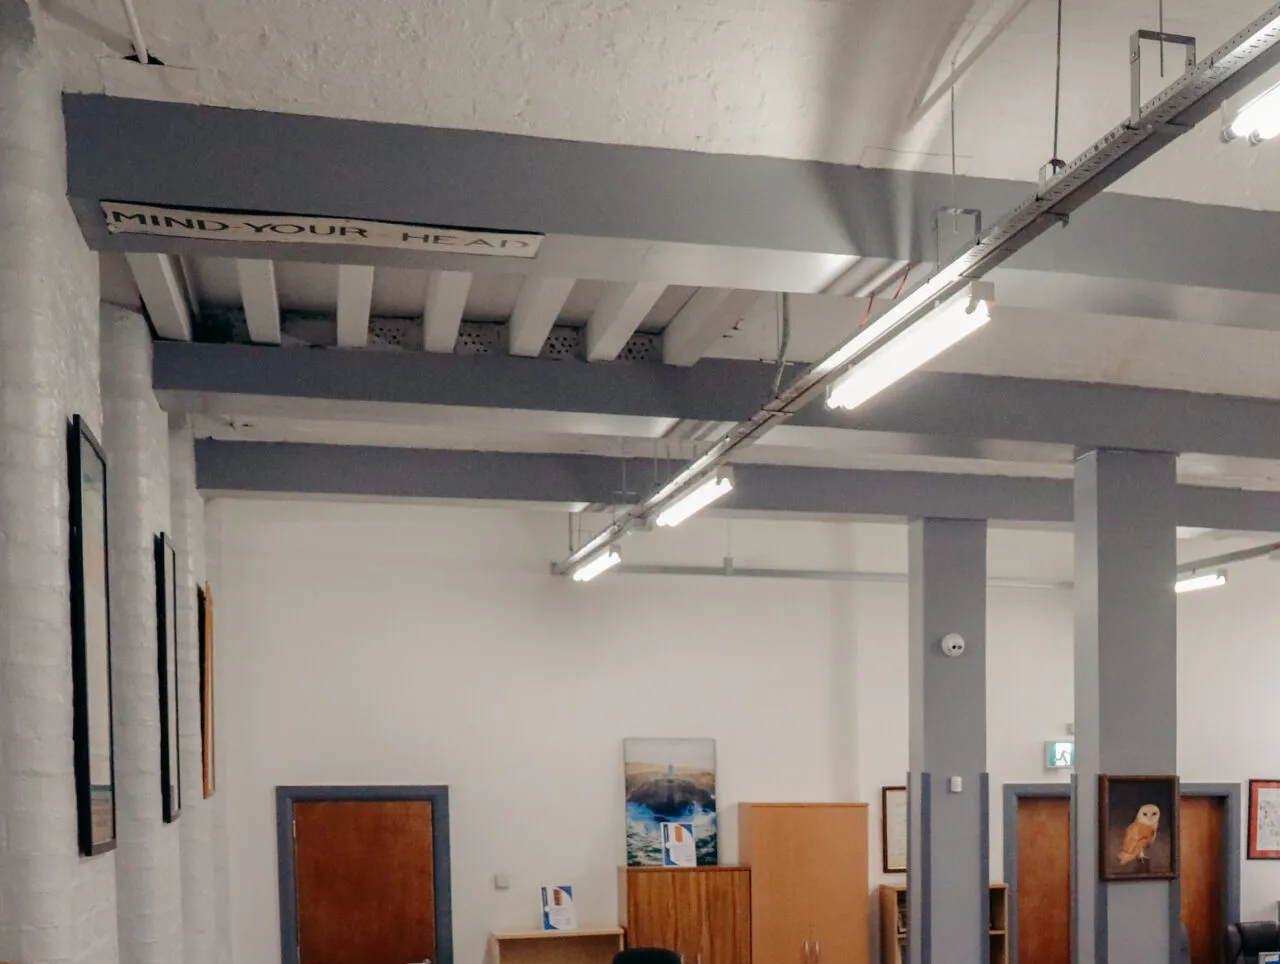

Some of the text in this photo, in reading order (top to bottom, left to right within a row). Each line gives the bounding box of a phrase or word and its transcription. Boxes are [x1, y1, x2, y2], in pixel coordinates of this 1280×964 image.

[111, 211, 529, 248] MIND YOUR HEAD
